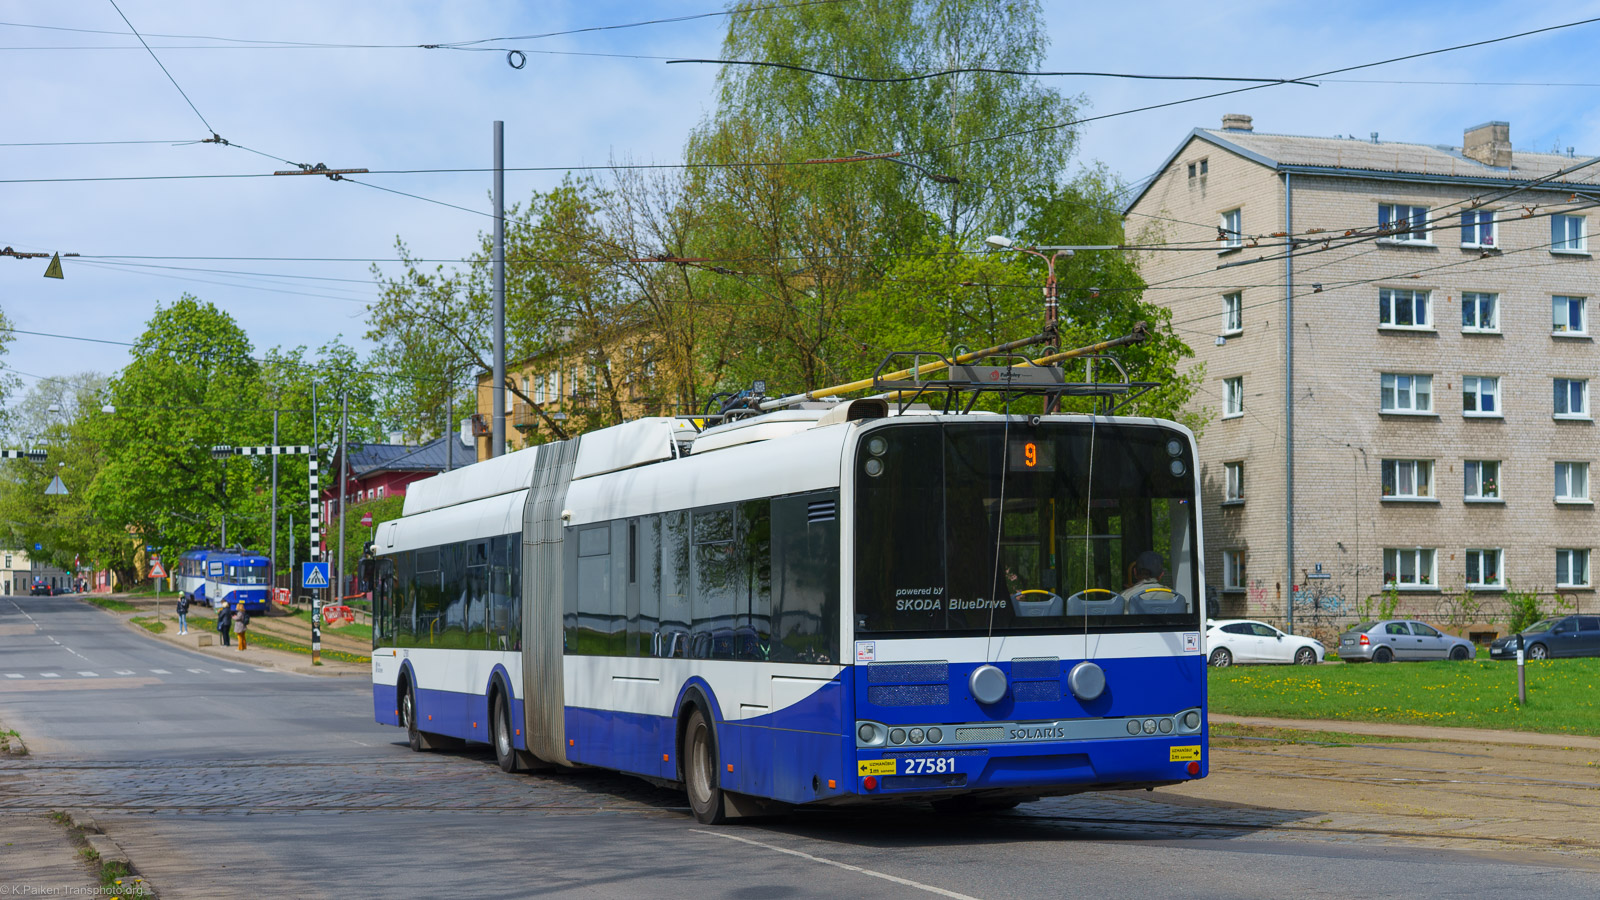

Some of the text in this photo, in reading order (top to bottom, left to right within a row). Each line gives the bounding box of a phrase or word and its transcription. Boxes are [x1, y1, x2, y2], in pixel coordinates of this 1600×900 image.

[1025, 443, 1036, 466] 9
[896, 586, 944, 597] powered by
[895, 598, 1007, 611] SKODA BlueDrive
[1010, 727, 1065, 740] SOLARIS
[904, 757, 955, 774] 27581
